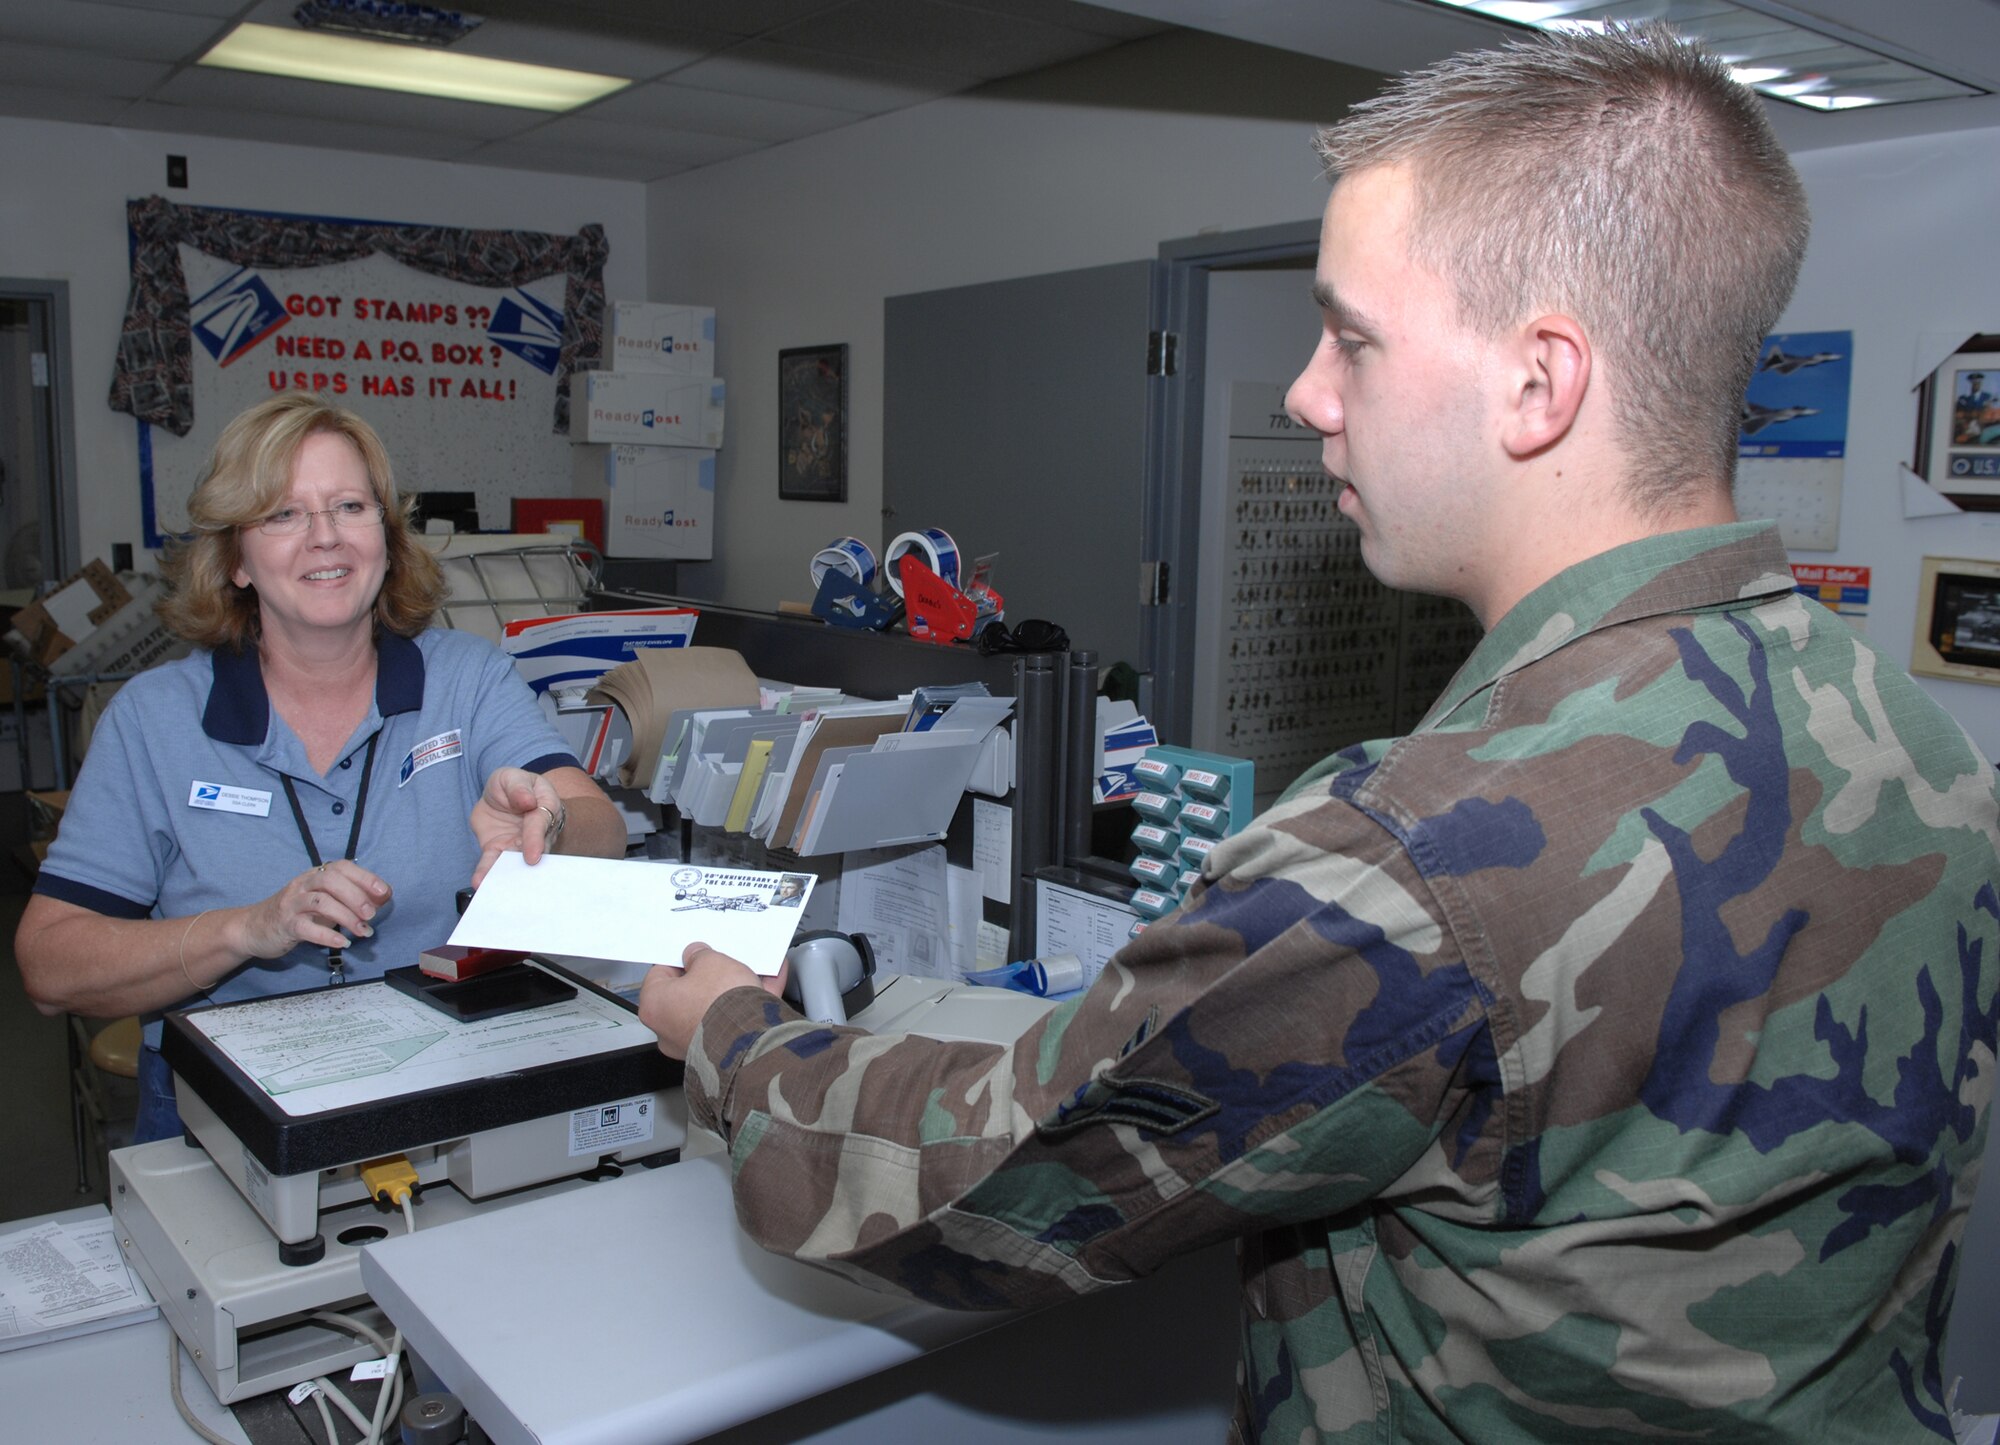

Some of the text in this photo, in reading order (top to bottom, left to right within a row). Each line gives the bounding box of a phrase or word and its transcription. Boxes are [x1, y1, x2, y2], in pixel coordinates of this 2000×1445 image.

[286, 294, 342, 318] GOT
[276, 336, 345, 360] NEED
[353, 340, 372, 361] A
[269, 371, 348, 394] USPS
[361, 375, 415, 398] HAS
[429, 377, 452, 398] IT
[1269, 414, 1291, 429] 770
[1795, 567, 1857, 581] Mail Safe
[103, 626, 169, 673] TED STATE
[139, 638, 176, 665] SERVI
[413, 740, 438, 756] UNITED
[414, 752, 441, 769] POSTAL
[241, 795, 270, 804] THOMPSON
